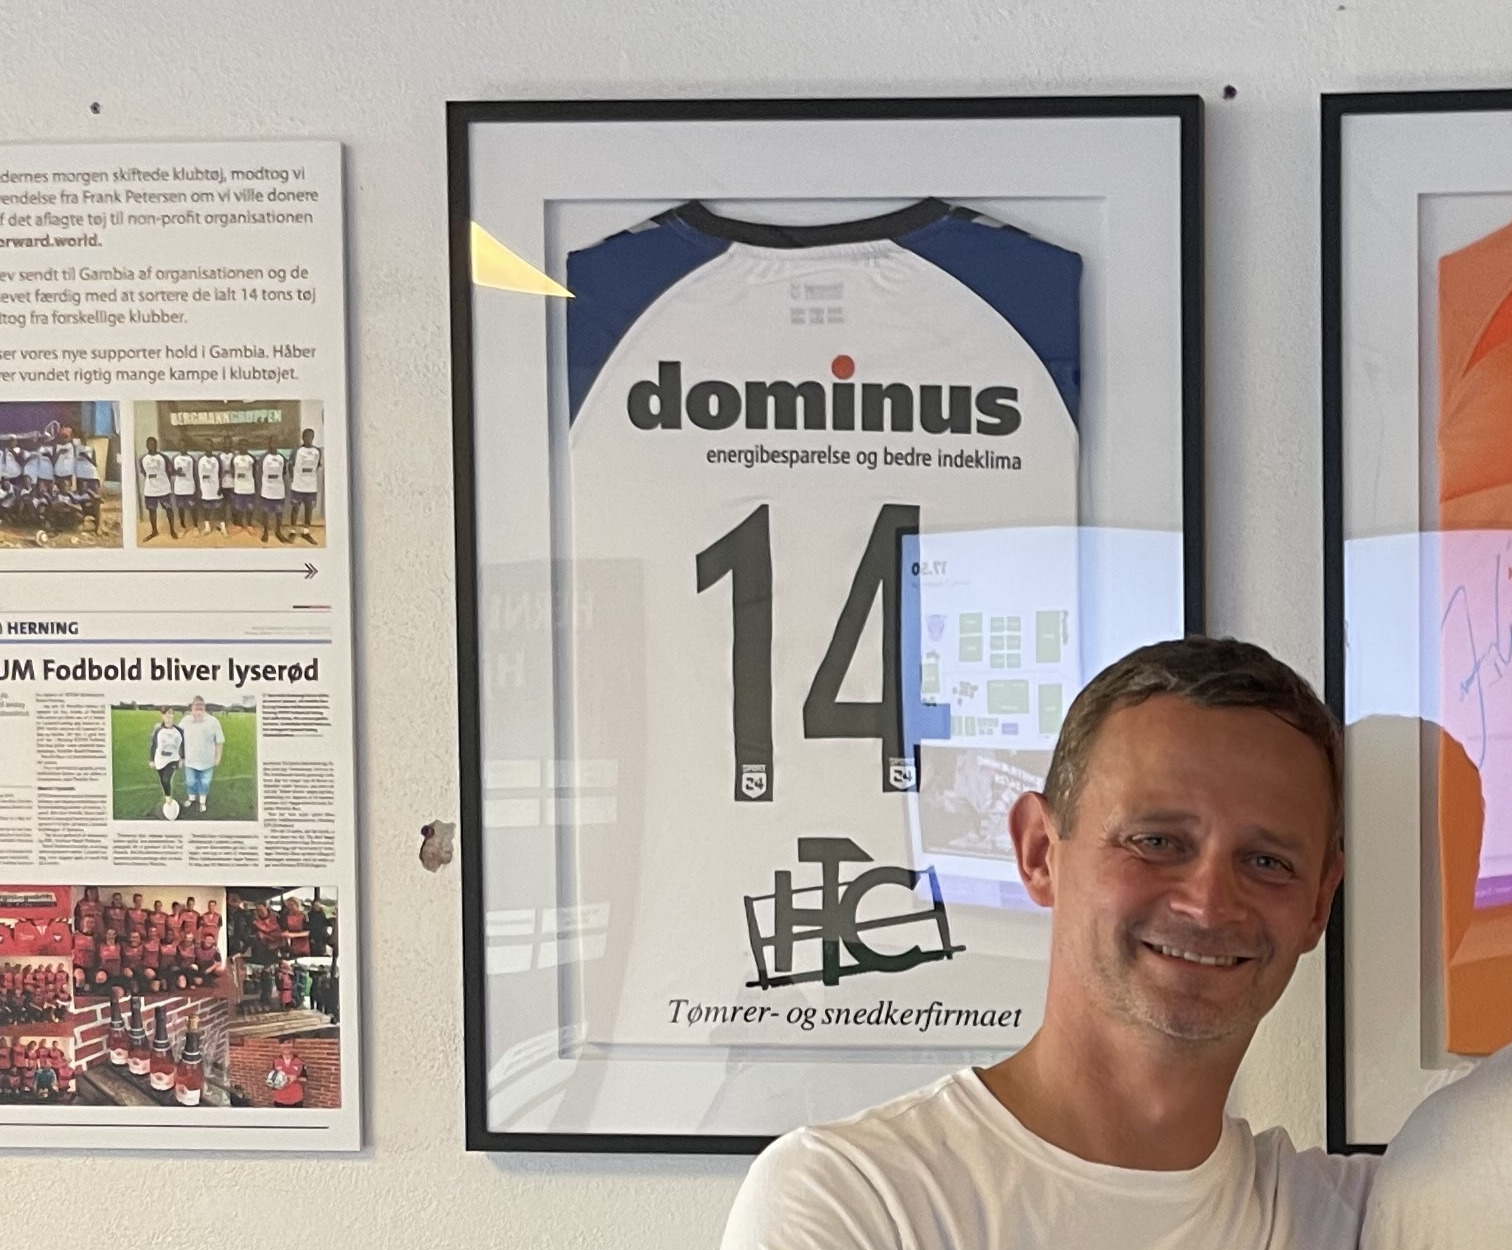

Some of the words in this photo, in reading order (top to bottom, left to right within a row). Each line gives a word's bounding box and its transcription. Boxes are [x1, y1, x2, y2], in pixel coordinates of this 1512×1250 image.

[53, 172, 108, 186] morgen
[113, 168, 170, 182] skiftede
[231, 168, 289, 184] modtog
[293, 167, 306, 180] vi
[0, 190, 56, 205] endelse
[60, 189, 78, 204] fra
[83, 189, 121, 203] Frank
[125, 189, 187, 203] Petersen
[190, 193, 214, 203] om
[218, 189, 231, 202] vi
[234, 188, 264, 202] ville
[267, 187, 319, 201] donere
[8, 213, 31, 227] det
[35, 212, 84, 229] aflagte
[88, 213, 108, 229] tøj
[110, 211, 124, 225] til
[128, 210, 200, 225] non-profit
[204, 211, 313, 228] organisationen
[19, 268, 59, 281] sendt
[62, 267, 76, 281] til
[79, 267, 135, 281] Gambia
[138, 266, 152, 280] af
[155, 266, 263, 283] organisationen
[268, 269, 286, 283] og
[290, 265, 309, 280] de
[35, 289, 81, 306] færdig
[85, 289, 117, 302] med
[121, 290, 136, 302] at
[139, 290, 189, 302] sortere
[192, 288, 211, 301] de
[242, 288, 258, 301] 14
[262, 289, 293, 301] tons
[297, 287, 317, 304] tøj
[30, 310, 48, 324] fra
[52, 309, 126, 327] forskellige
[129, 308, 187, 324] klubber.
[20, 349, 59, 360] vores
[62, 348, 87, 363] nye
[91, 347, 161, 362] supporter
[165, 345, 198, 359] hold
[209, 344, 270, 358] Gambia.
[273, 343, 317, 358] Håber
[19, 368, 70, 382] vundet
[73, 367, 112, 384] rigtig
[116, 369, 166, 384] mange
[169, 367, 219, 383] kampe
[229, 366, 299, 383] klubtøjet.
[627, 354, 1023, 436] dominus
[706, 445, 851, 468] energibesparelse
[857, 450, 878, 470] og
[883, 447, 932, 468] bedre
[937, 449, 1022, 470] indeklima
[7, 621, 79, 635] HERNING
[695, 502, 921, 802] 14
[42, 657, 142, 681] Fodbold
[150, 657, 221, 681] bliver
[228, 657, 319, 688] lyserød
[668, 999, 780, 1024] Tømrer-
[787, 1007, 818, 1032] og
[821, 1000, 1023, 1032] snedkerfirmaet
